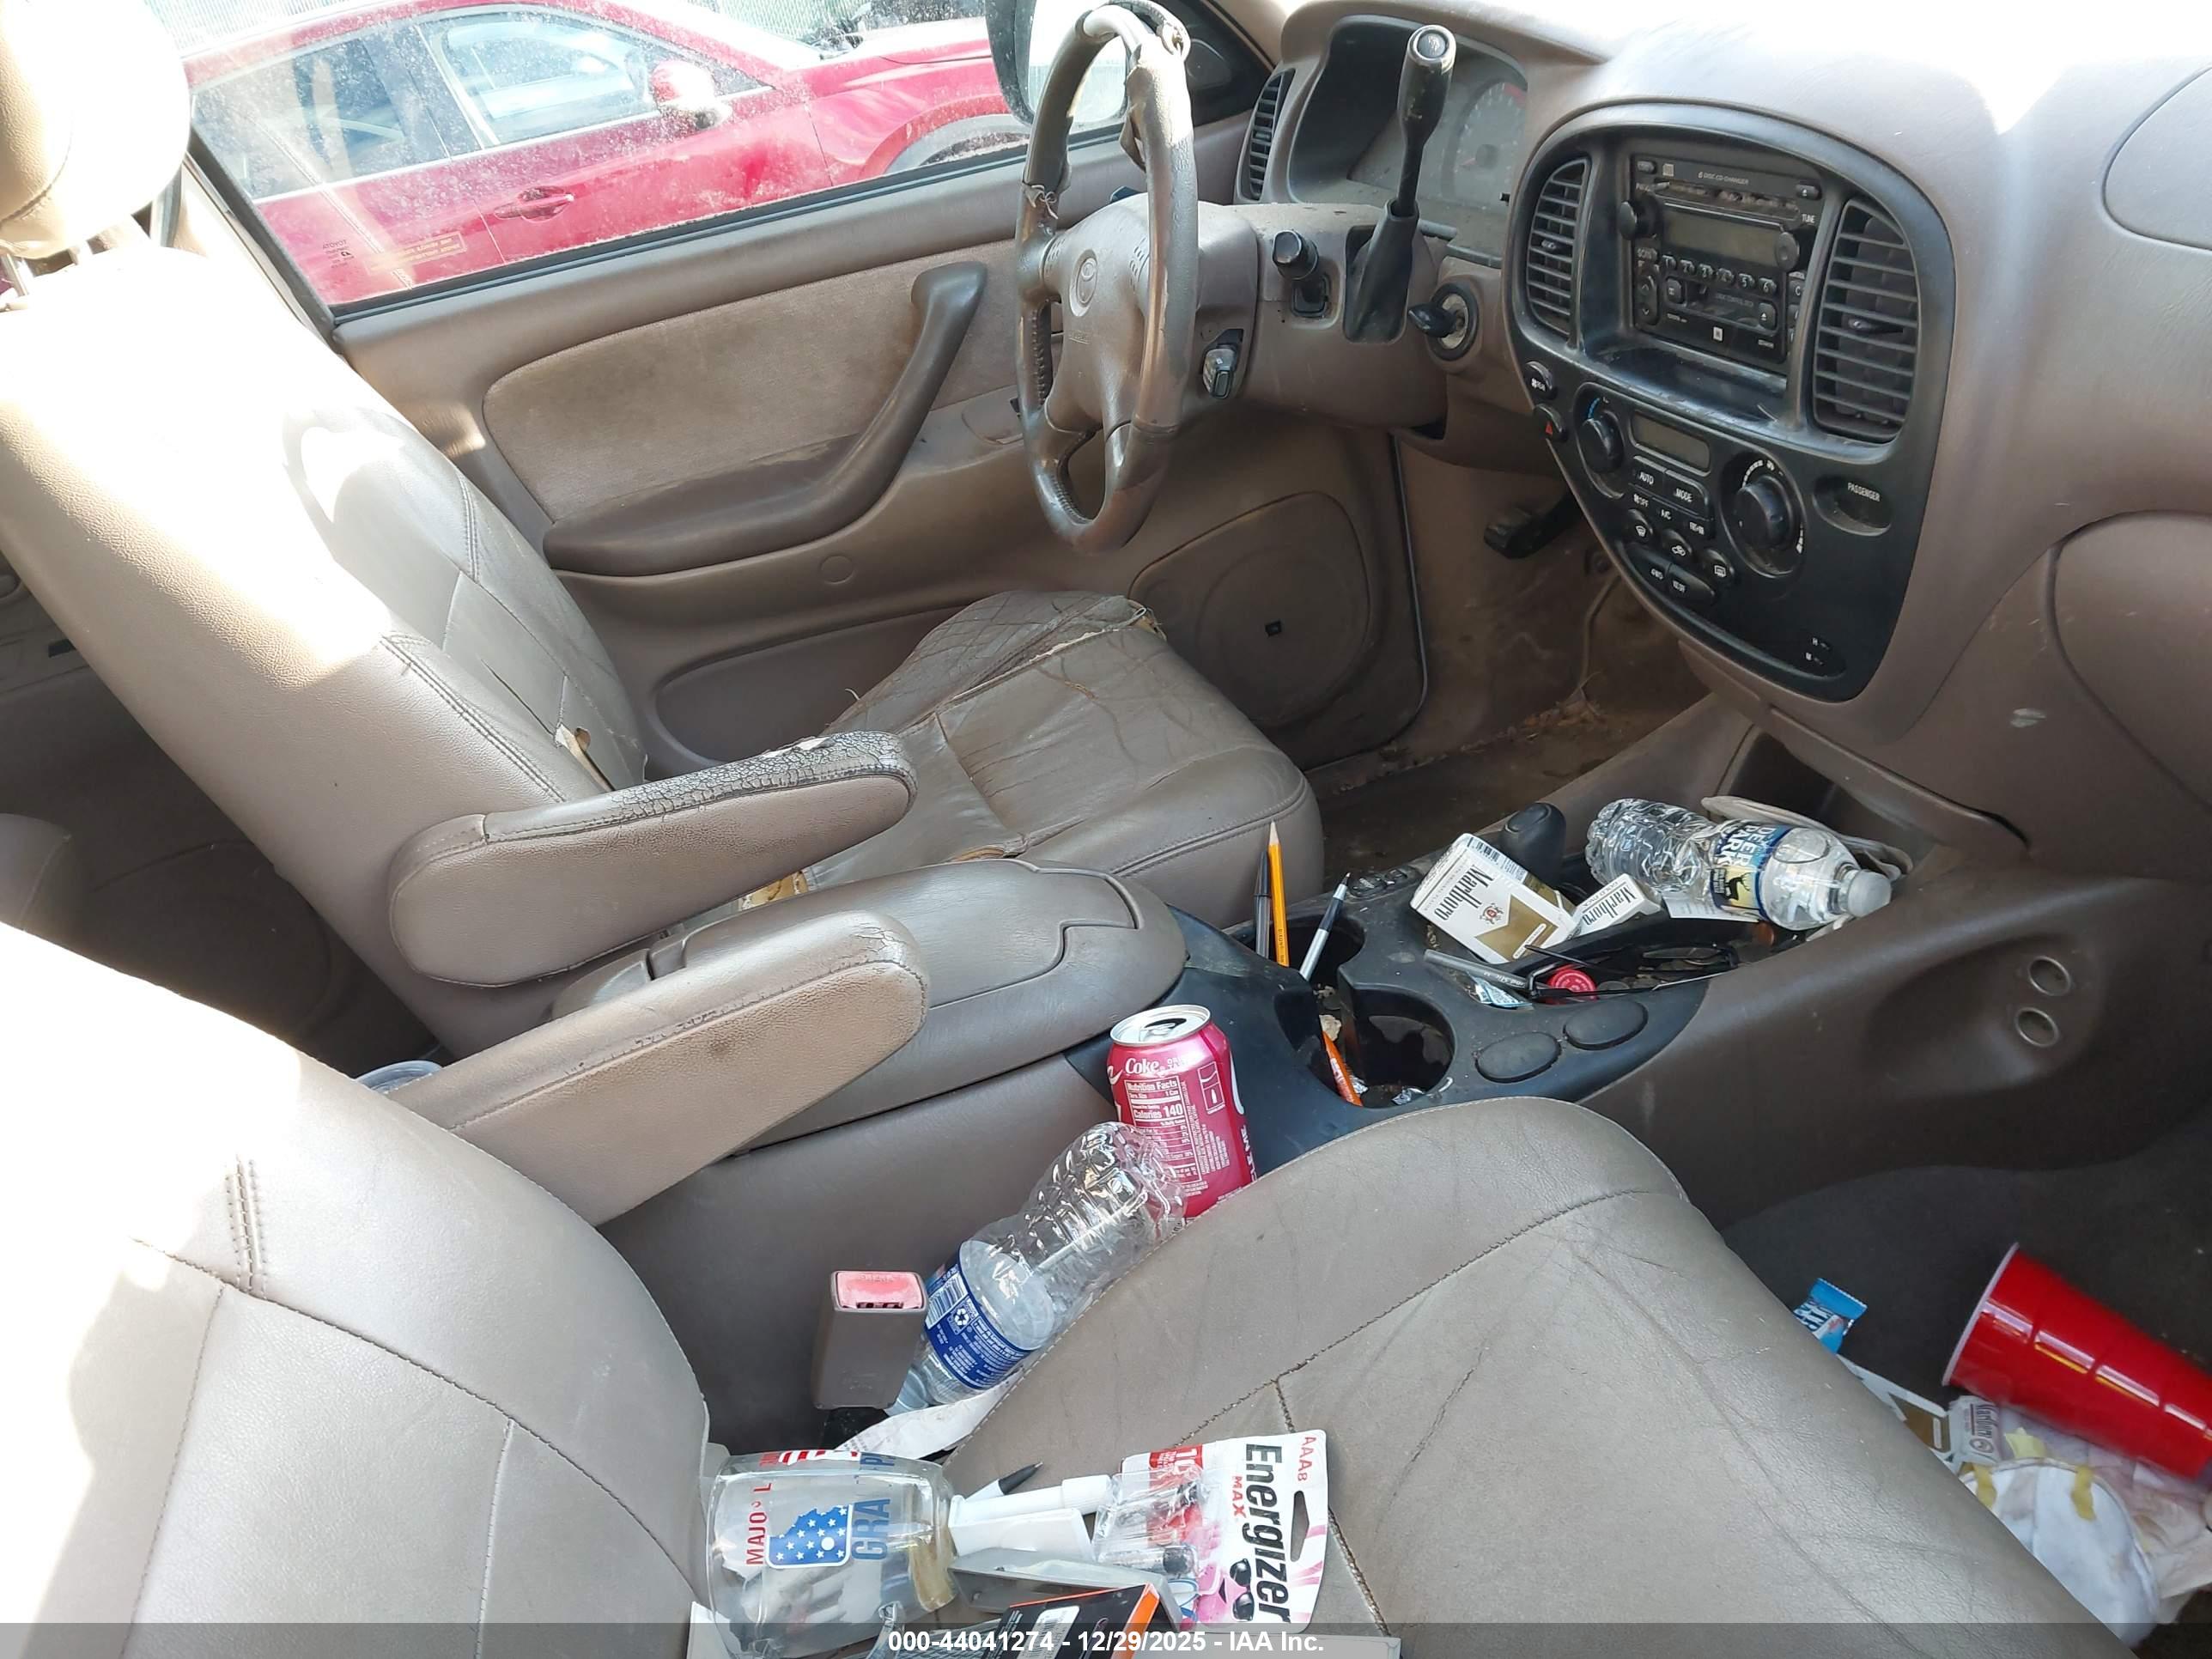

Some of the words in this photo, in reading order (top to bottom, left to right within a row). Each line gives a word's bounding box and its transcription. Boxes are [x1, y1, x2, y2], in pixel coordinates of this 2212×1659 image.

[1638, 471, 1655, 486] AUTO
[1847, 482, 1881, 503] PASSENGER
[1712, 825, 1758, 866] PARK
[1731, 827, 1776, 867] DEER
[1437, 863, 1495, 921] Marlboro
[1583, 886, 1633, 926] Marlboro
[1124, 1055, 1160, 1077] Coke
[1157, 1080, 1176, 1090] Facts
[1163, 1104, 1183, 1116] 140
[1232, 1475, 1247, 1518] MAX
[1245, 1443, 1291, 1623] Energizer
